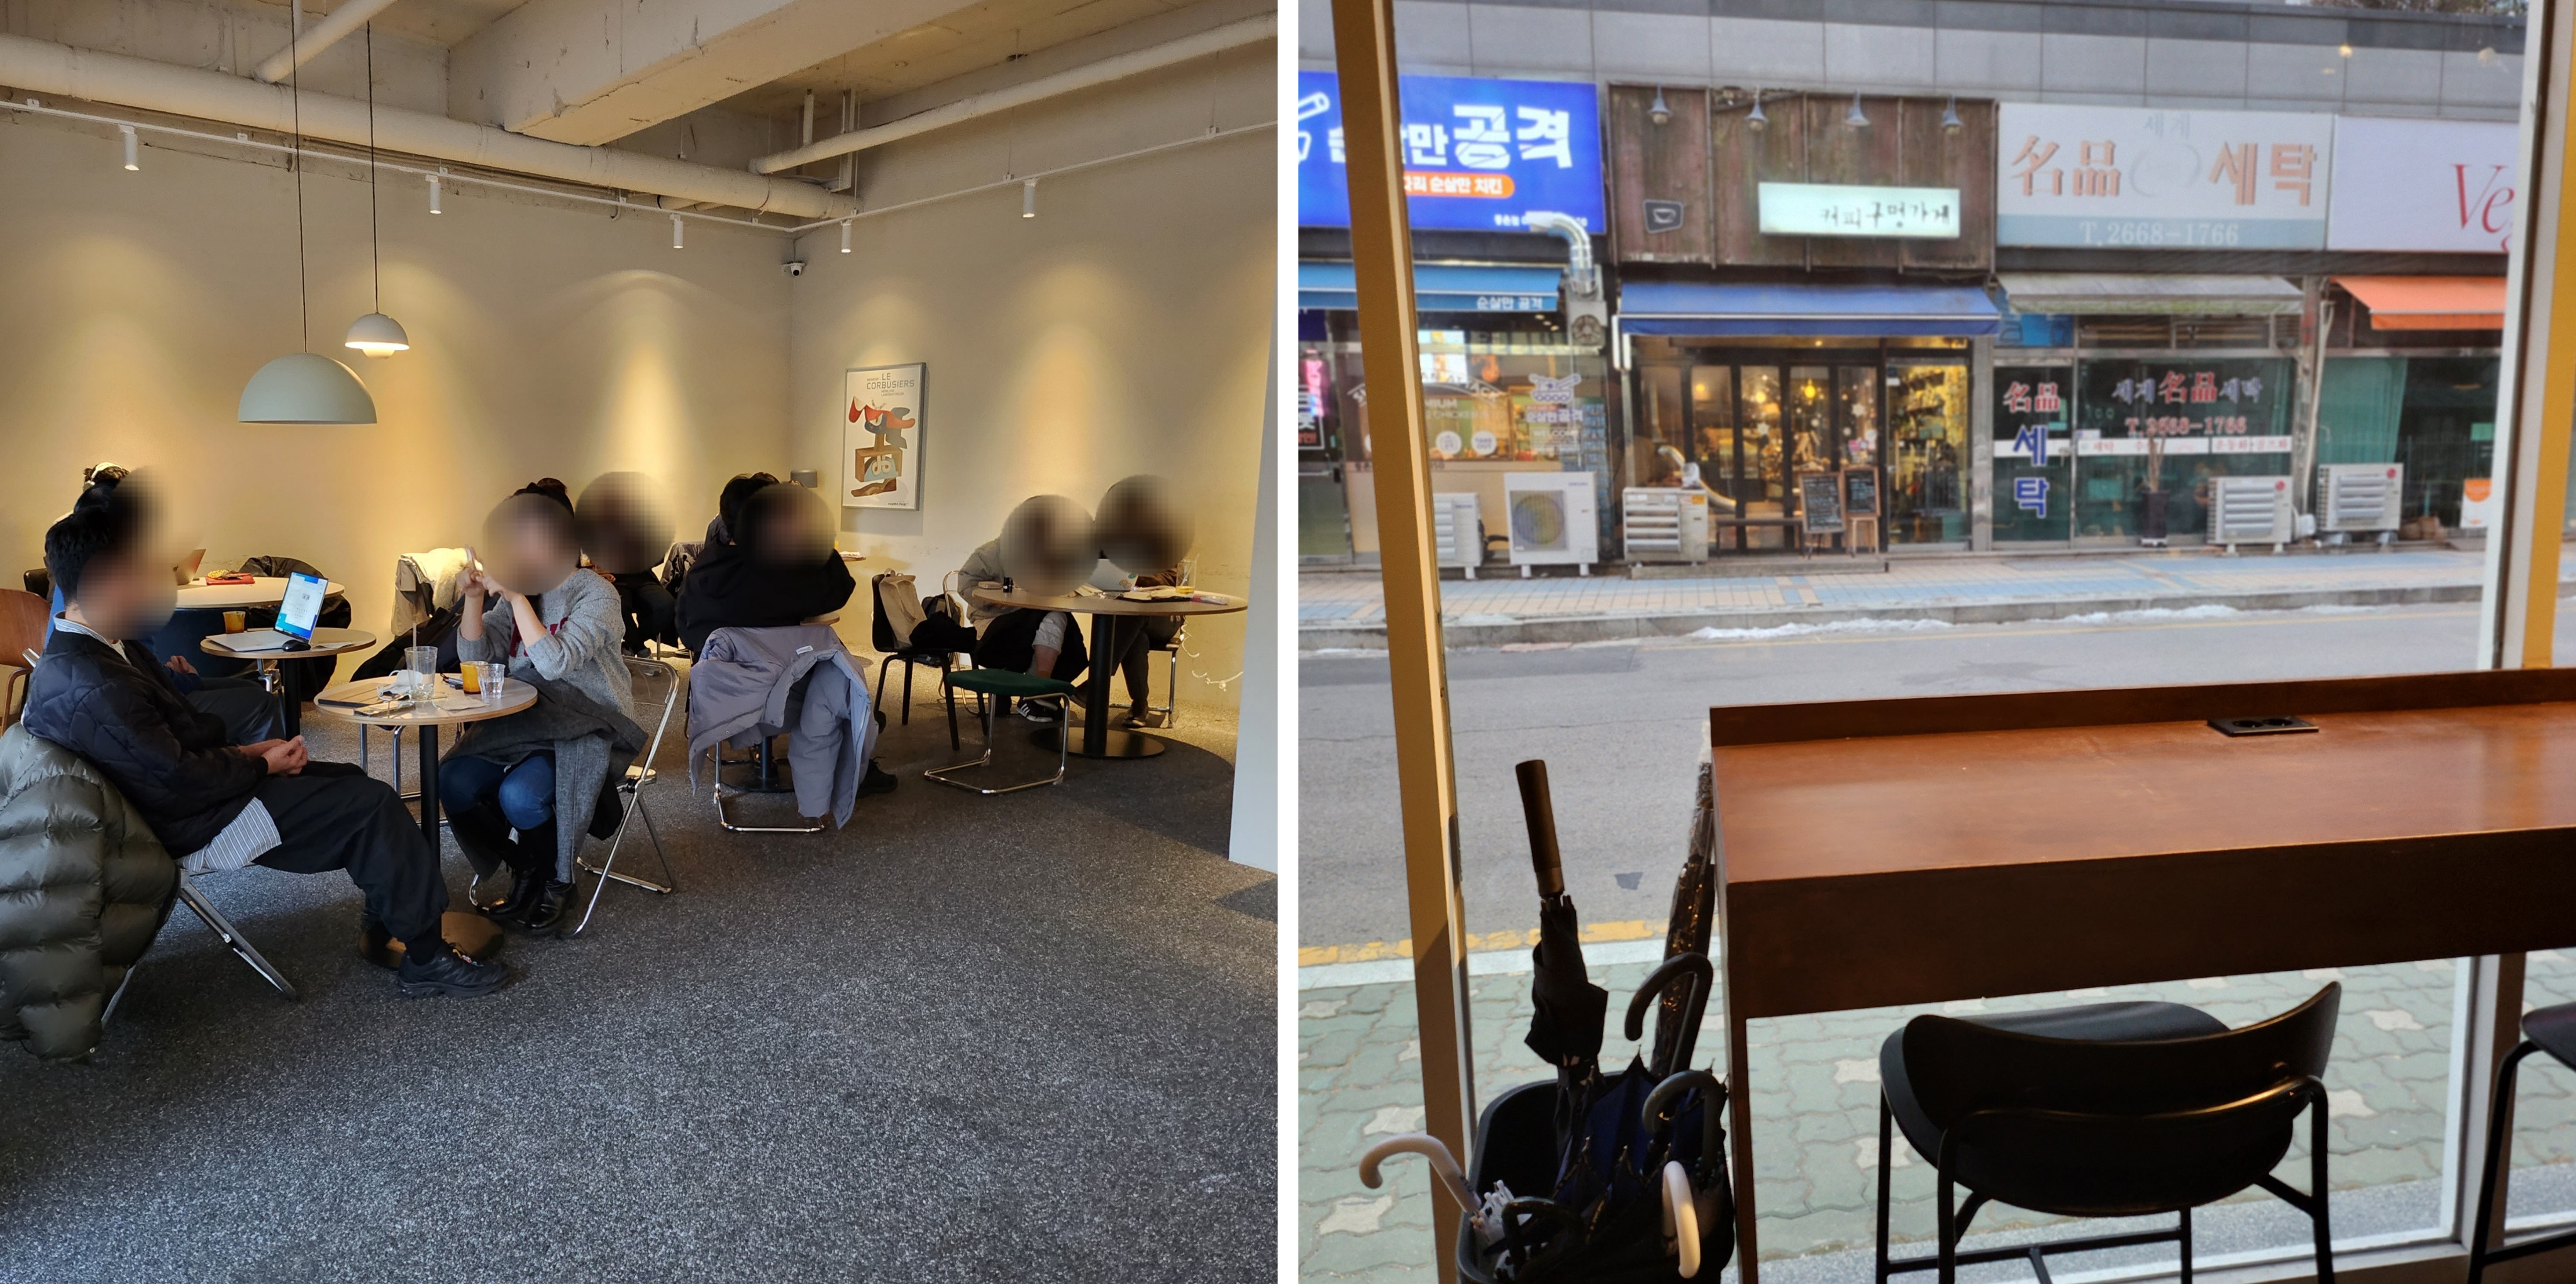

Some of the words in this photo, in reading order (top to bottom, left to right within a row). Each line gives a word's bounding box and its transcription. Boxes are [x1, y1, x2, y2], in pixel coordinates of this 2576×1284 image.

[2010, 135, 2121, 197] 名品
[2209, 140, 2317, 206] 세탁
[2450, 163, 2515, 254] Ve
[2079, 222, 2239, 246] T.2668-1766
[1477, 296, 1514, 311] 순살만
[1518, 297, 1543, 311] 공격
[867, 380, 914, 389] CORBUSIERS
[2002, 380, 2061, 413] 名品
[2158, 370, 2218, 404] 名品
